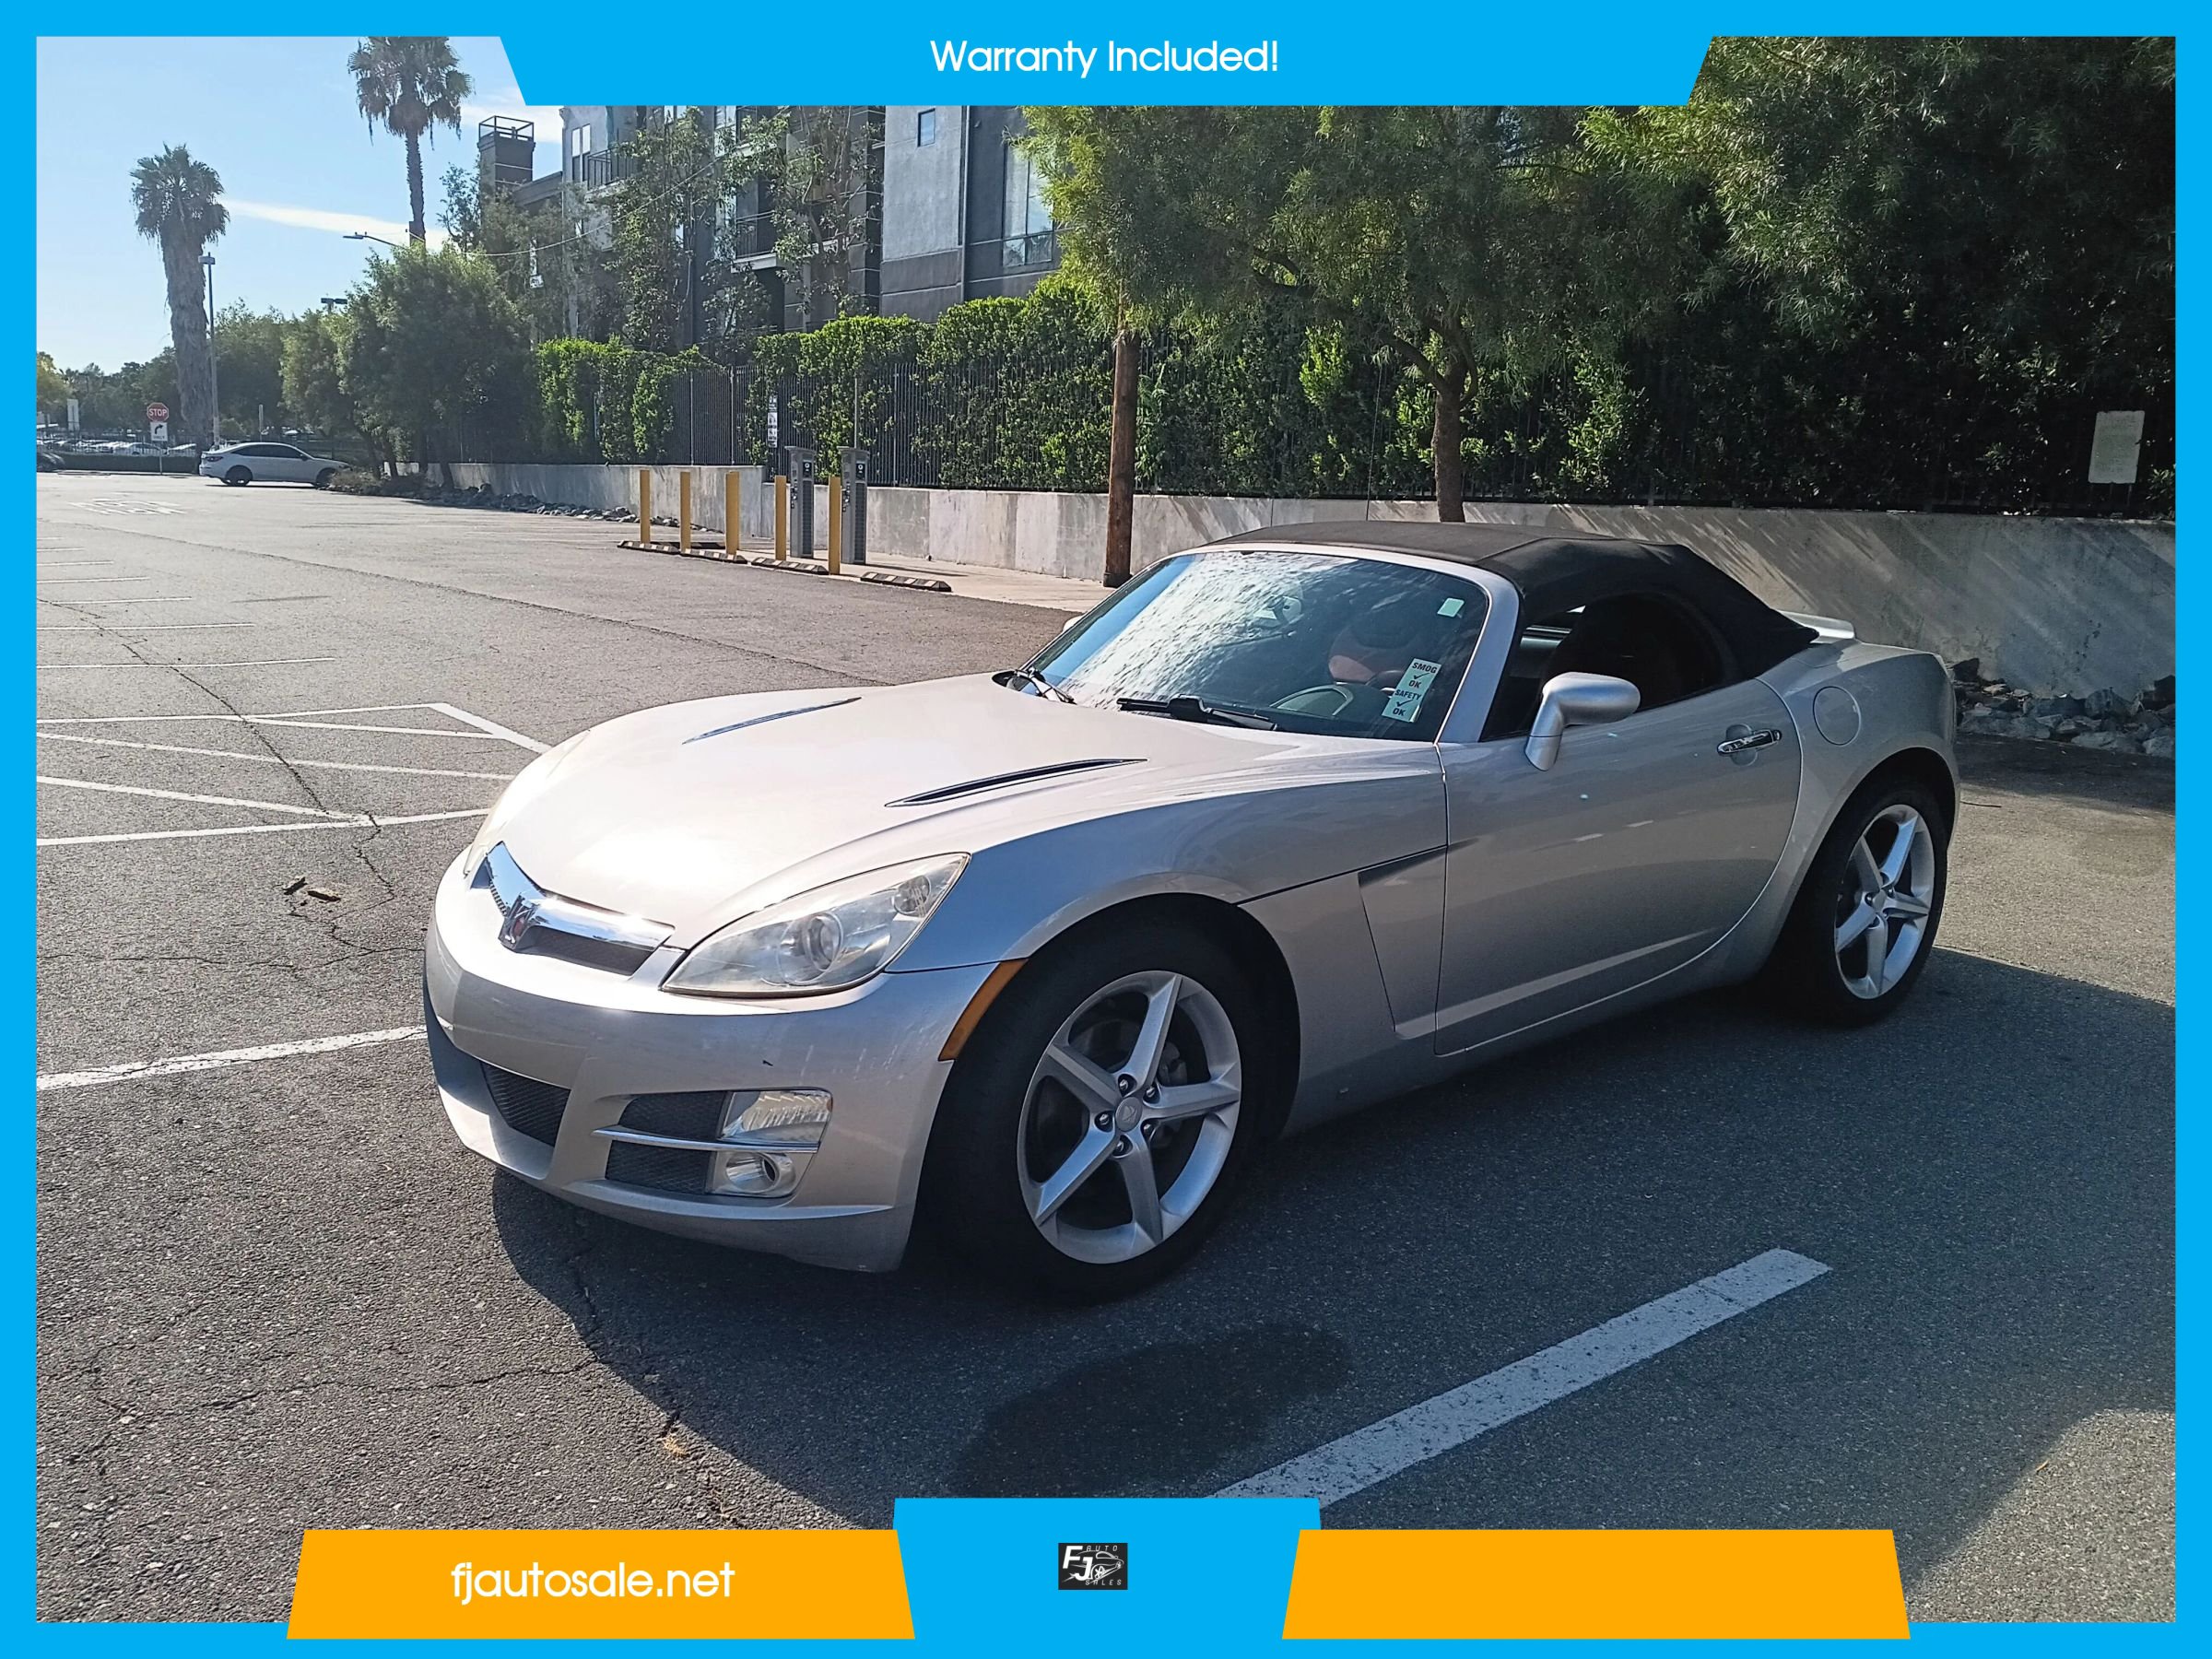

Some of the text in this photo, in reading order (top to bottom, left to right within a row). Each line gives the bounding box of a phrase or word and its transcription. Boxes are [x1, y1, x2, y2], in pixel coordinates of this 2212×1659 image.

[148, 408, 168, 417] STOP
[1412, 662, 1438, 674] SMOG
[1408, 680, 1422, 688] OK
[1394, 688, 1422, 700] SAFETY
[1393, 708, 1406, 716] OK
